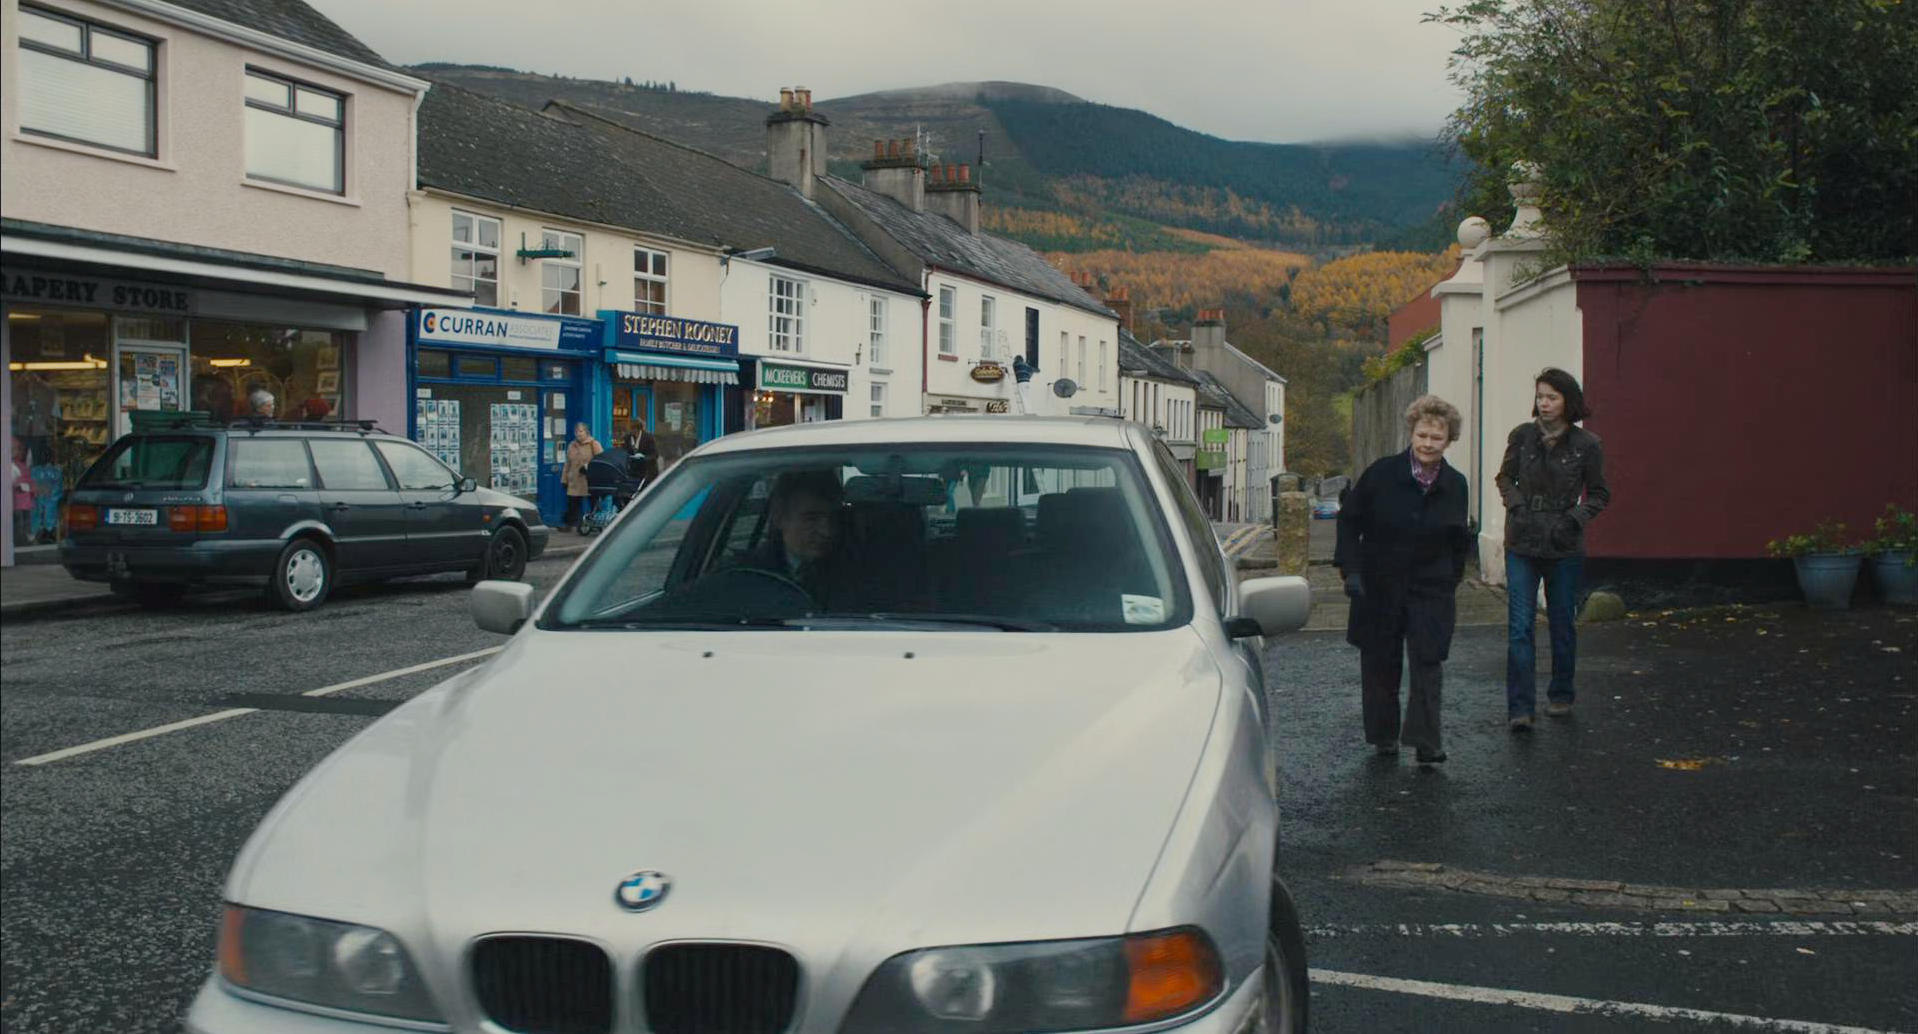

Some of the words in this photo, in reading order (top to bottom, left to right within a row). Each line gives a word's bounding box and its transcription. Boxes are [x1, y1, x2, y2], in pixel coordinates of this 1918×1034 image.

[113, 285, 189, 310] STORE
[440, 316, 508, 337] CURRAN
[623, 314, 682, 339] STEPHEN
[684, 322, 733, 344] ROONEY
[812, 372, 845, 388] CHEMISTS
